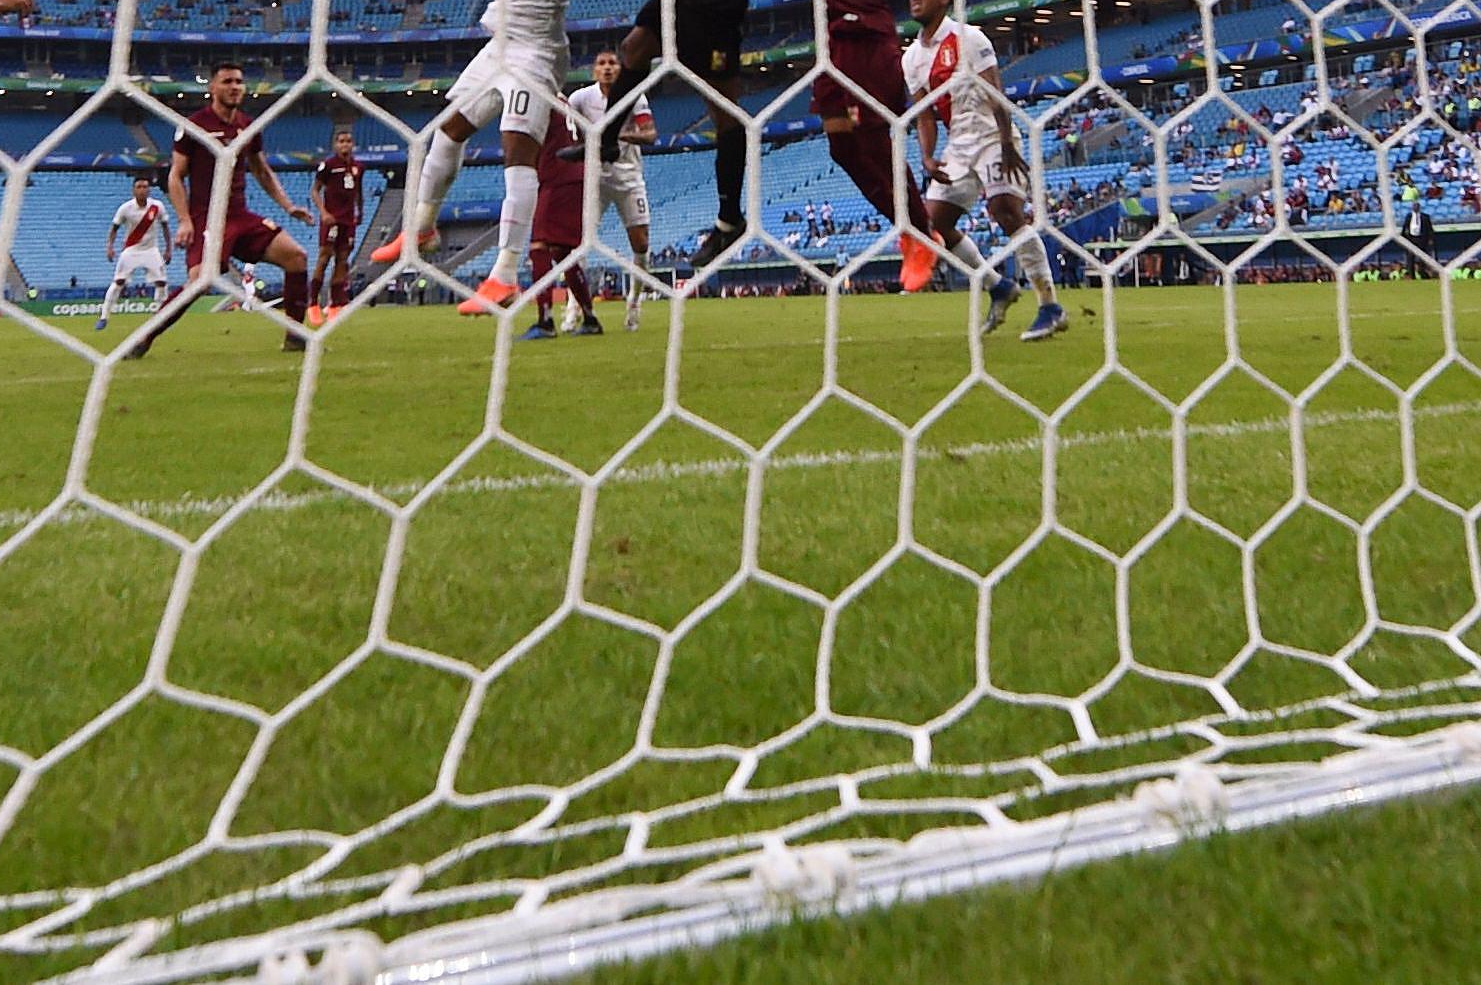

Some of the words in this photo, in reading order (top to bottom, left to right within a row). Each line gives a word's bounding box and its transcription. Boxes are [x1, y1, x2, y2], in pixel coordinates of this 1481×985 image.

[507, 89, 530, 115] 10
[986, 162, 1004, 183] 13
[636, 198, 646, 213] 9
